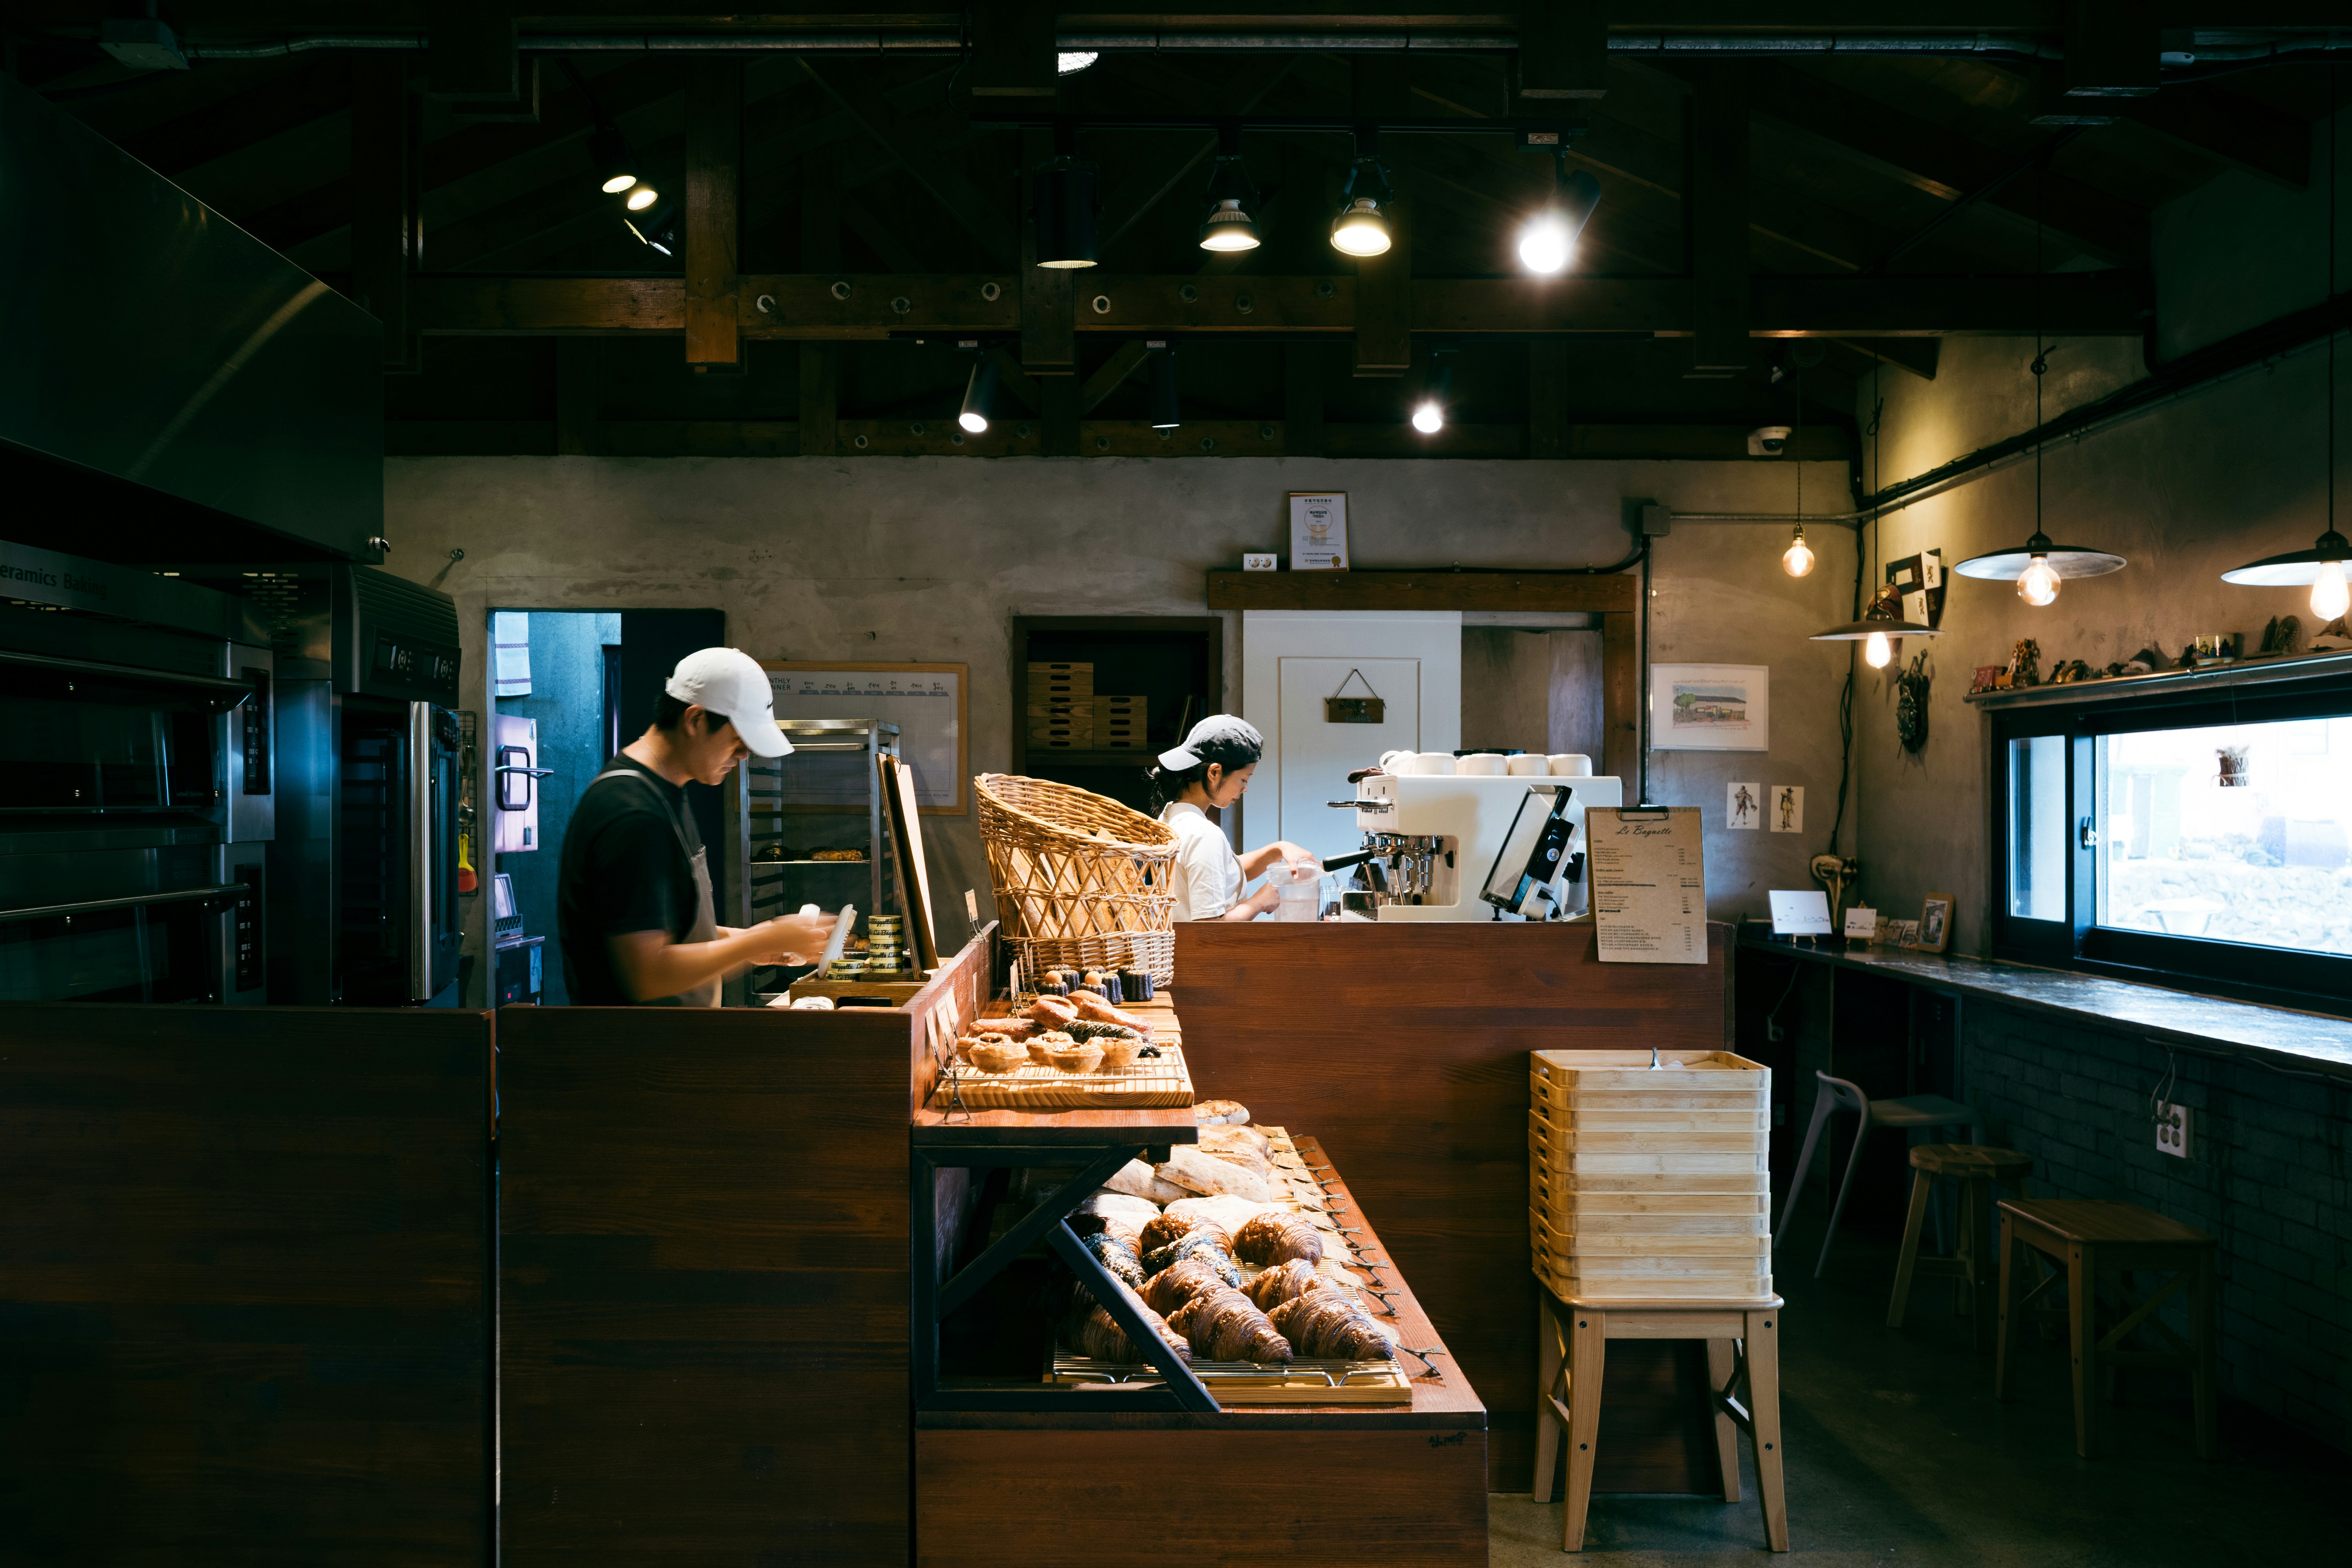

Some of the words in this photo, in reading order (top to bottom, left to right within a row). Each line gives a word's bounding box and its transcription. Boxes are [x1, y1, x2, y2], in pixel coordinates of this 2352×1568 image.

[0, 565, 57, 587] eramics
[64, 573, 107, 601] Baking
[1615, 826, 1630, 835] Le
[1632, 825, 1672, 838] Baguette
